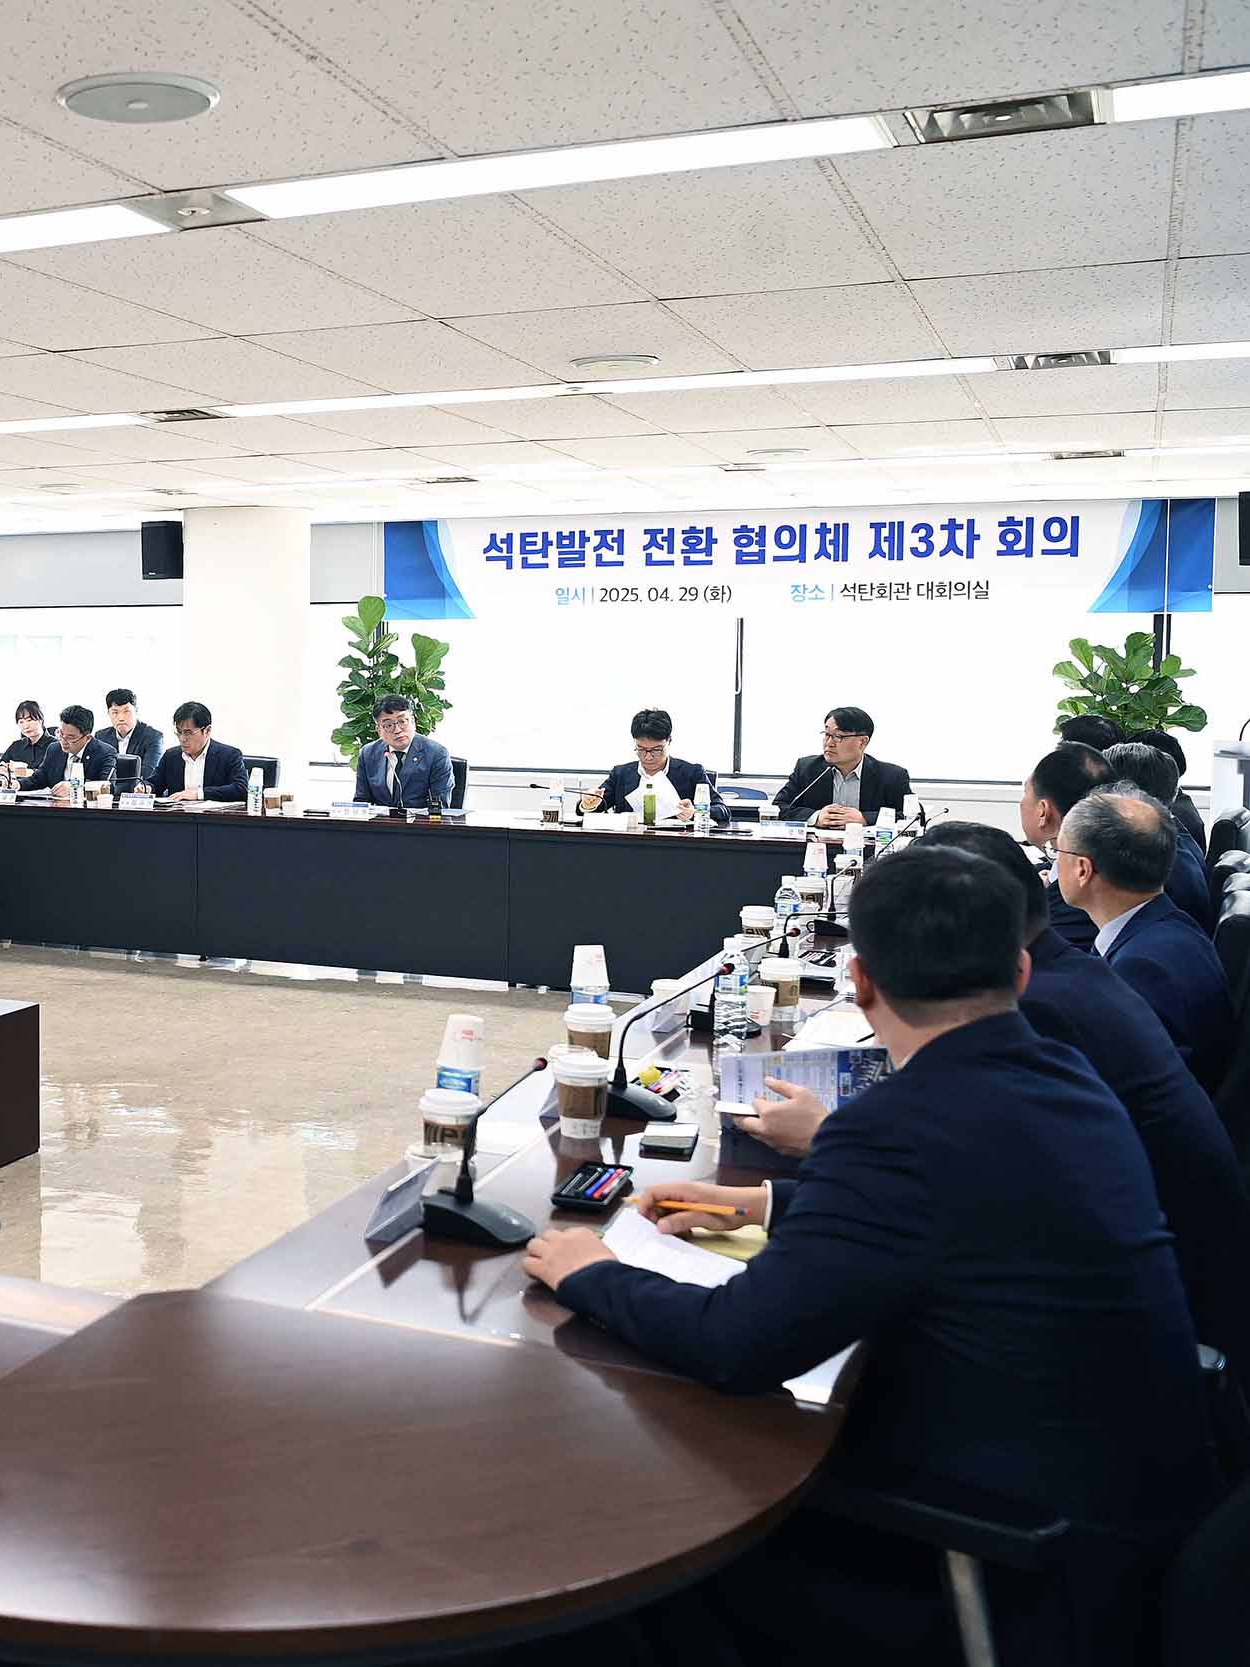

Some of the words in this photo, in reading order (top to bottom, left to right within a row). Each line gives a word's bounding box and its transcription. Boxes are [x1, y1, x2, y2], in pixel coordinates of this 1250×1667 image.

[482, 528, 625, 571] 석탄발전
[642, 525, 719, 567] 전환
[732, 521, 850, 566] 협의체
[868, 517, 981, 561] 제3차
[996, 515, 1080, 558] 회의
[554, 585, 586, 606] 일시
[599, 587, 643, 603] 2025.
[647, 587, 674, 603] 04.
[678, 586, 699, 603] 29
[703, 585, 733, 604] (화)
[790, 582, 826, 603] 장소
[840, 581, 912, 602] 석탄회관
[916, 579, 990, 601] 대회의실
